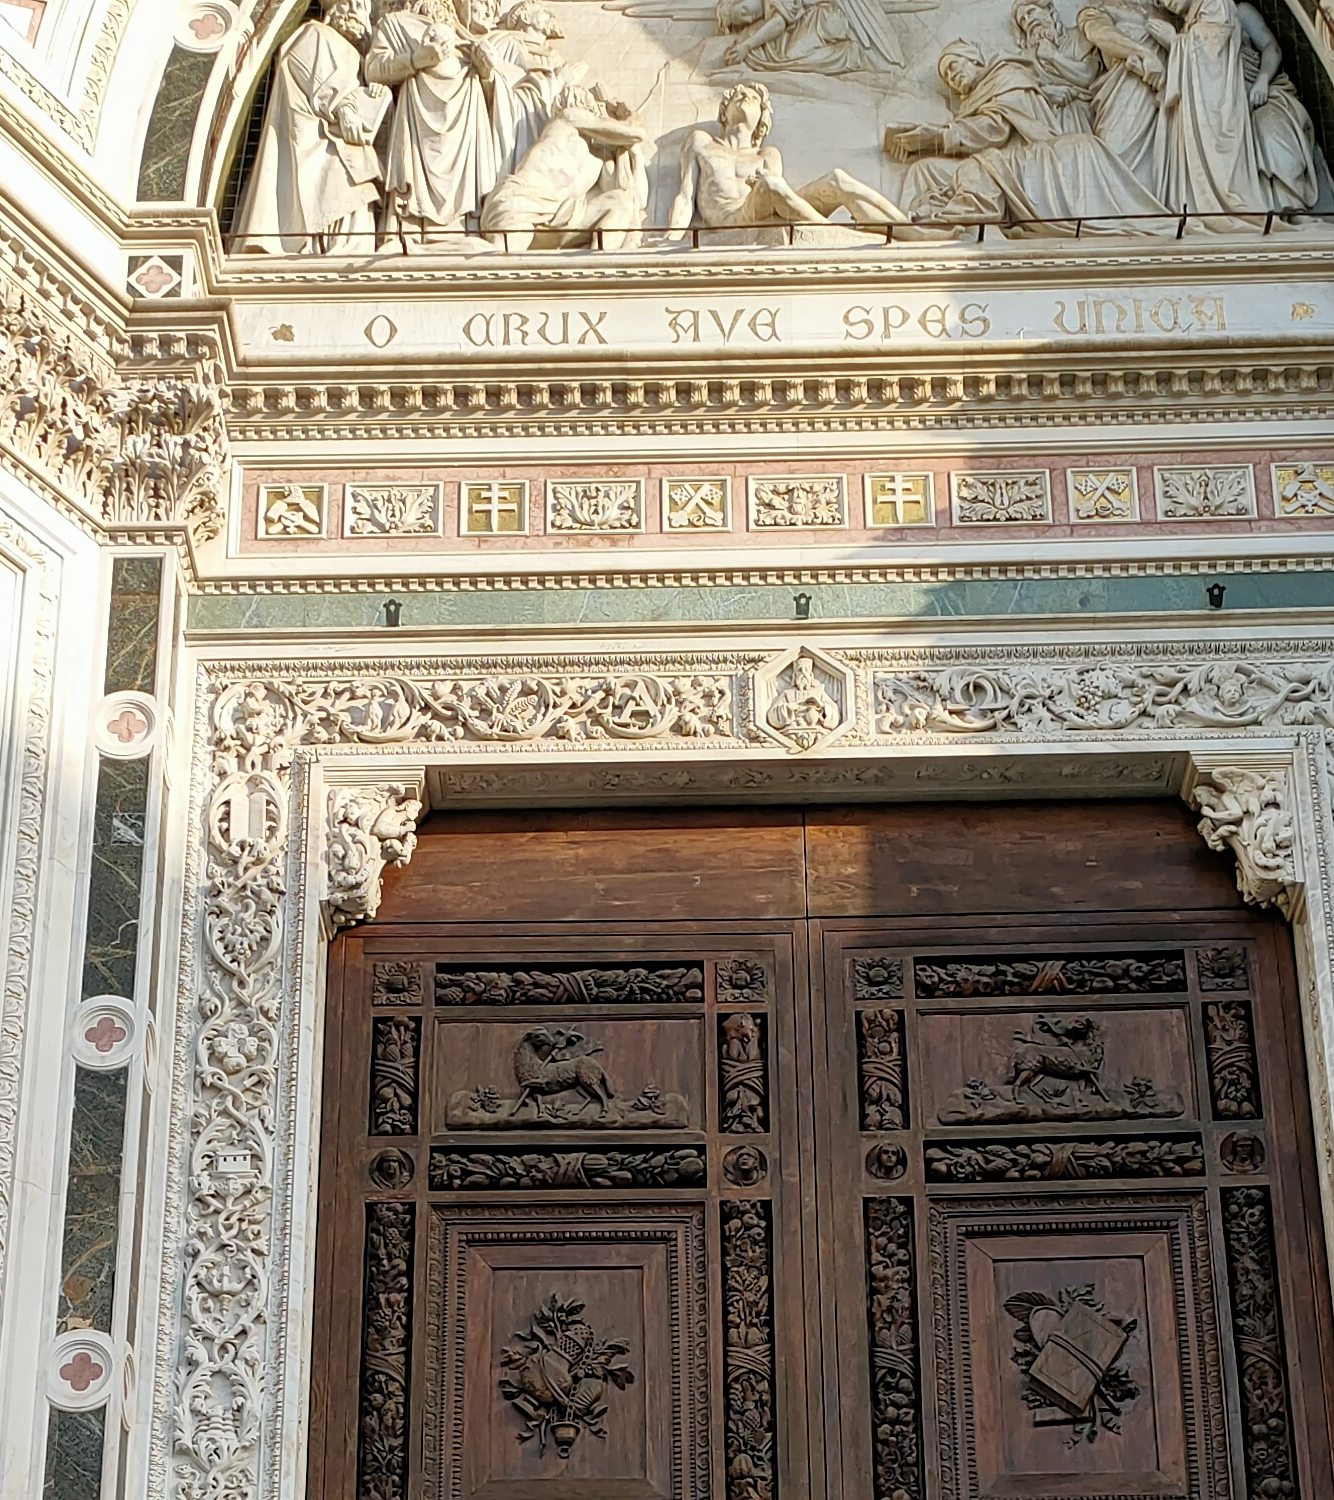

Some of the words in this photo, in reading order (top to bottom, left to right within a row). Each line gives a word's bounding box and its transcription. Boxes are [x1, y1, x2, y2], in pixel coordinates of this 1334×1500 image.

[363, 314, 398, 348] O
[462, 311, 609, 347] CRUX
[665, 306, 782, 343] AVE
[842, 303, 991, 340] SPES
[1053, 294, 1227, 335] UNICA
